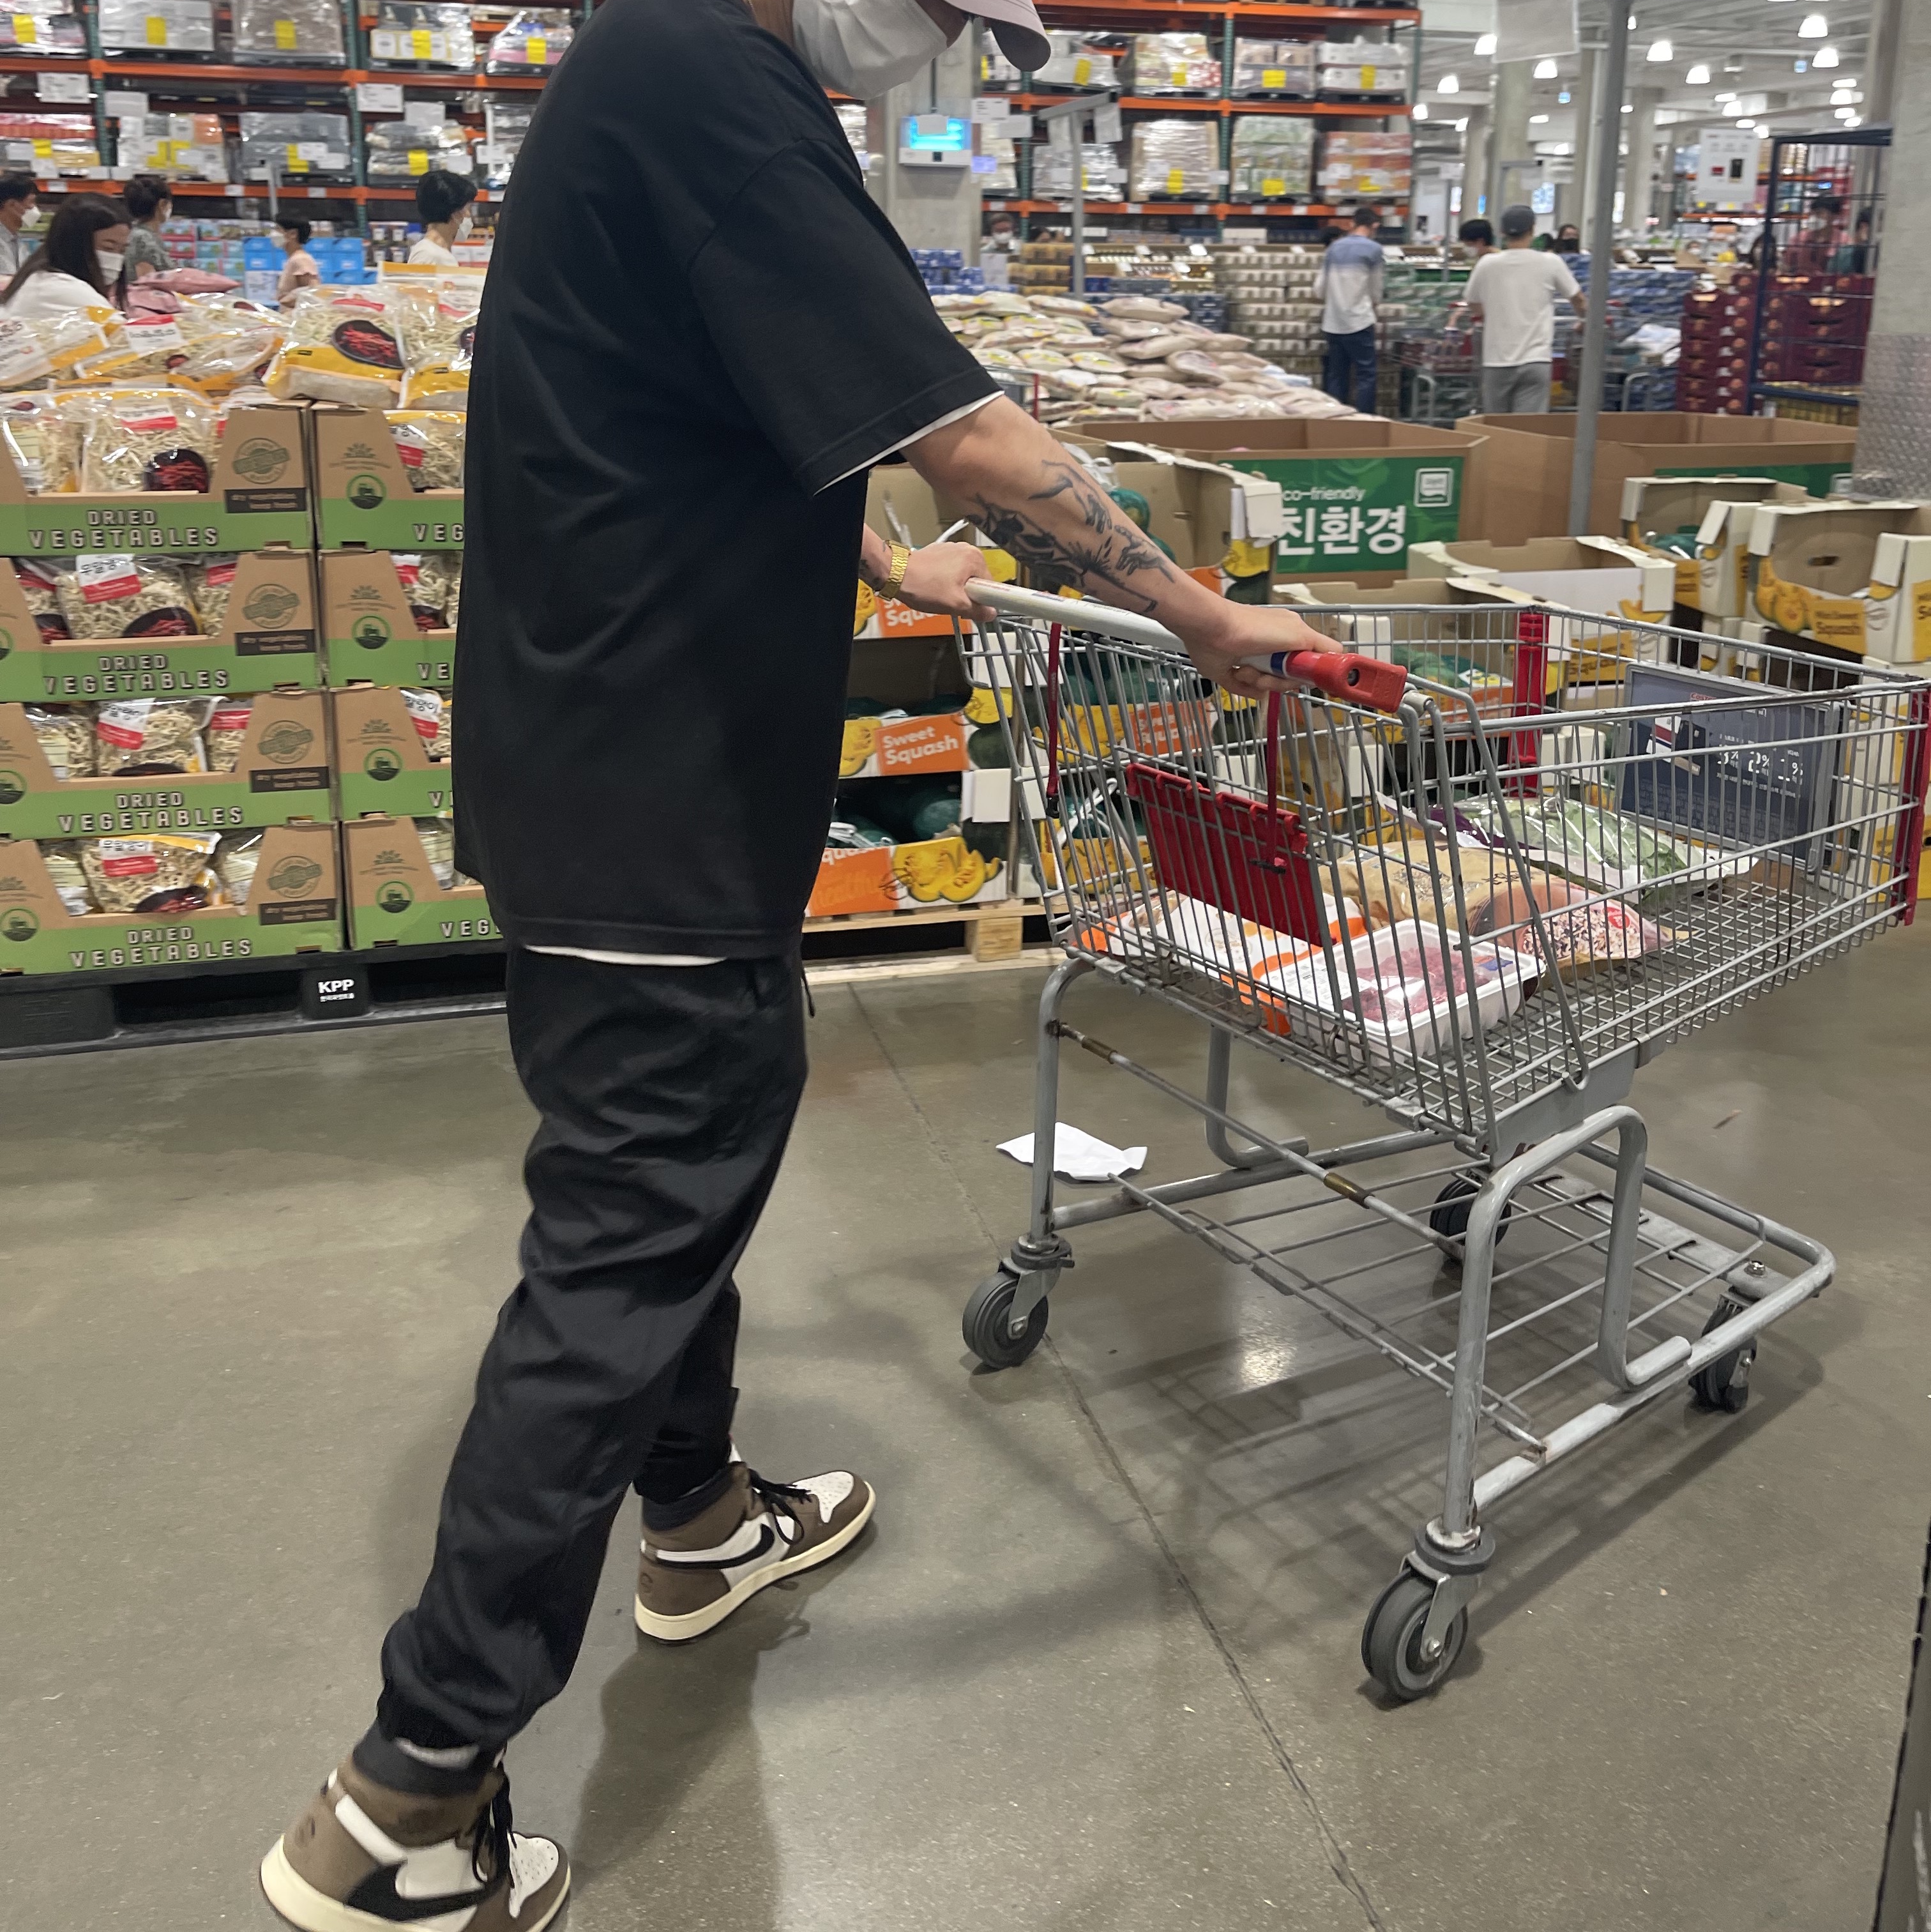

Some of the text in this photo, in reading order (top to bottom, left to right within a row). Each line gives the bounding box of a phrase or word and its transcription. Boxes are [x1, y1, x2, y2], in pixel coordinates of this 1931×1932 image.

[1282, 486, 1366, 501] co-friendly
[87, 510, 156, 525] DRIED
[28, 528, 219, 548] VEGETABLES
[1278, 505, 1406, 555] 친환경
[98, 655, 168, 671] DRIED
[43, 669, 229, 694] VEGETABLES
[882, 726, 935, 749] Sweet
[885, 734, 958, 765] Squash
[115, 791, 183, 809] DRIED
[58, 806, 243, 833] VEGETABLES
[127, 926, 193, 945] DRIED
[68, 938, 252, 968] VEGETABLES
[319, 979, 354, 994] KPP
